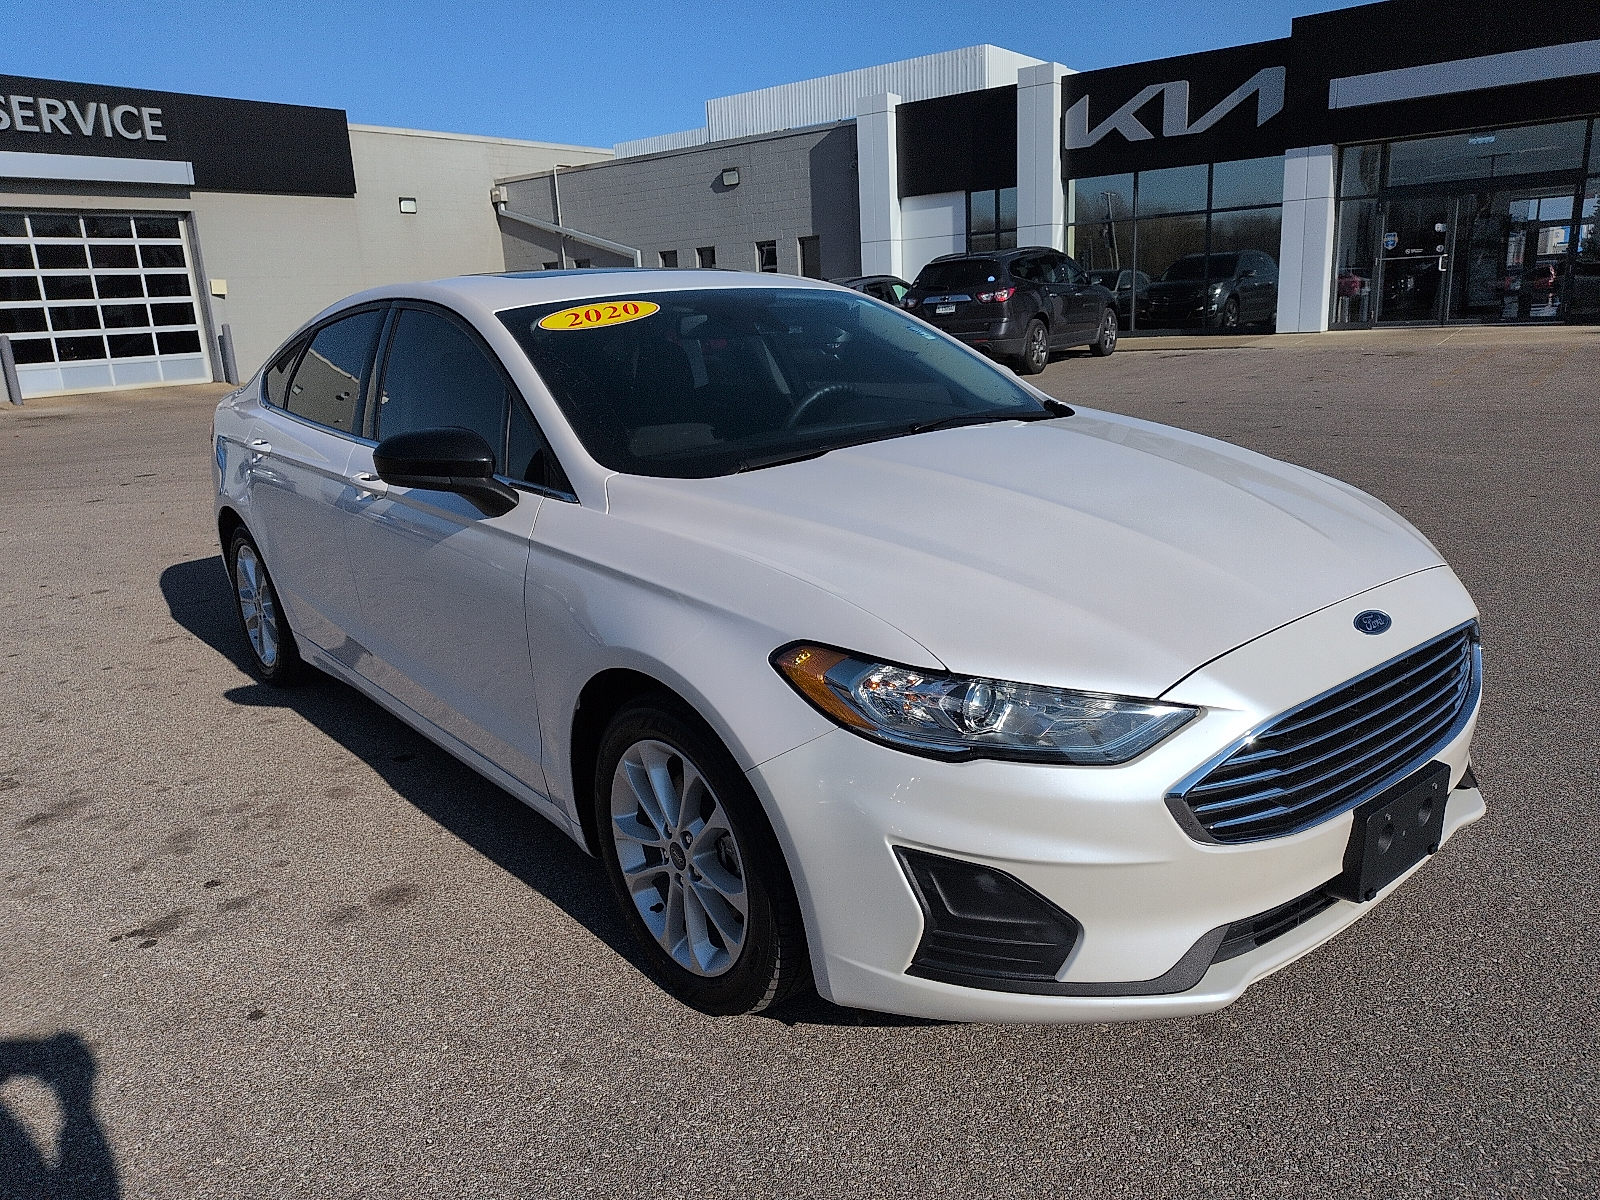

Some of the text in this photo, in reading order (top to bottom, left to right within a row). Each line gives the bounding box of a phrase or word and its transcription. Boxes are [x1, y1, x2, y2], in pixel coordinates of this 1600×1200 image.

[1065, 66, 1287, 150] KIA
[564, 303, 639, 327] 2020
[1361, 614, 1385, 631] Ford
